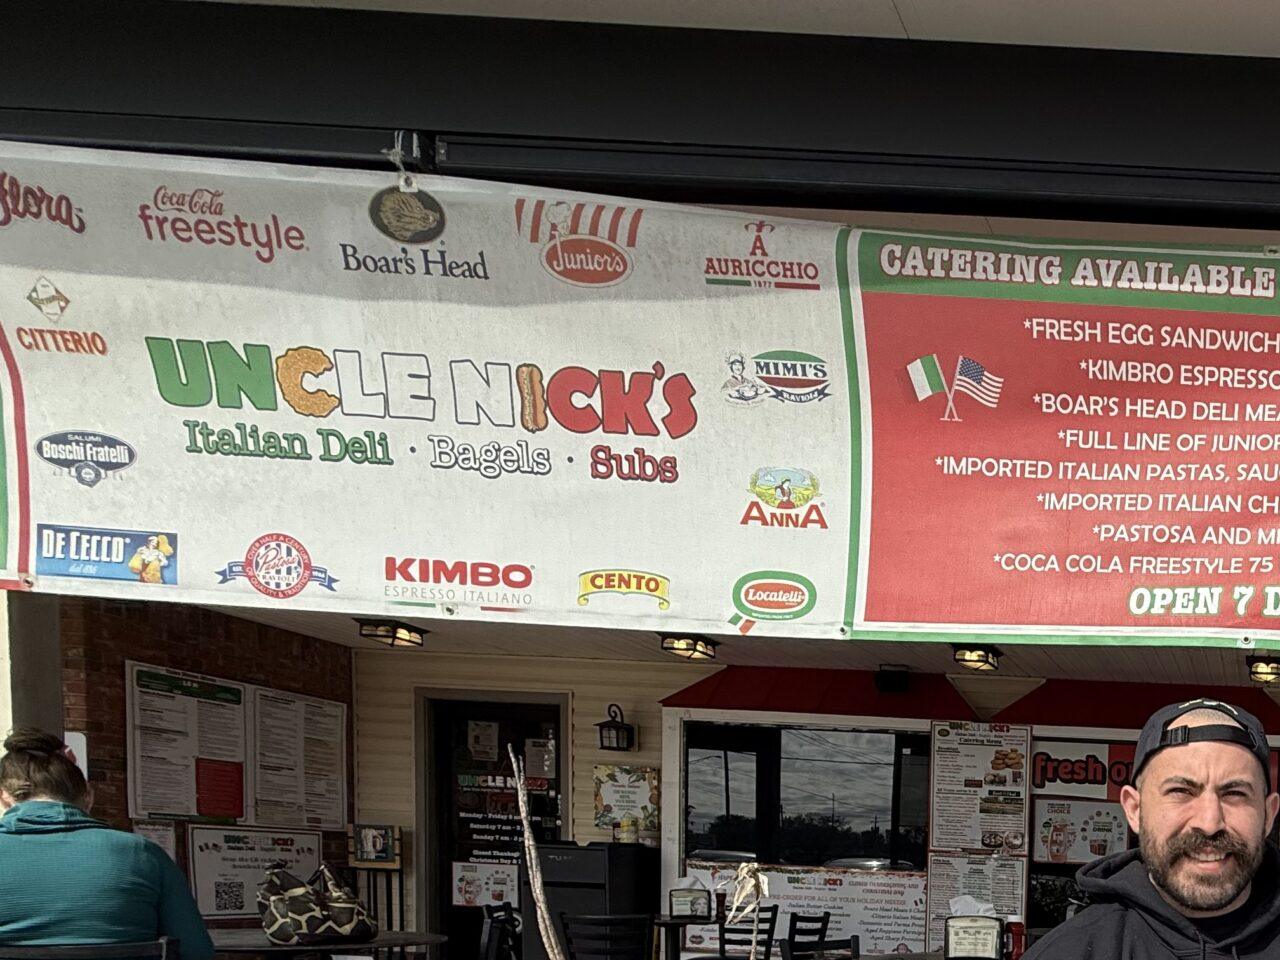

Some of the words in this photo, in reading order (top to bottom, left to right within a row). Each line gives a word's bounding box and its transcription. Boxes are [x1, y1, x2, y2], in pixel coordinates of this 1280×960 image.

[138, 205, 305, 263] freestyle
[339, 242, 417, 275] Boar's
[423, 247, 489, 279] Head
[552, 231, 626, 272] Junior's
[705, 257, 819, 280] AURICCHIO
[880, 243, 1061, 285] CATERING
[1071, 258, 1276, 298] AVAILABLE
[16, 327, 108, 355] CITTERIO
[1108, 323, 1153, 346] EGG
[756, 361, 827, 377] MIMI'S
[144, 336, 436, 422] UNCLE
[450, 360, 698, 439] NICK'S
[1125, 398, 1187, 420] HEAD
[1193, 401, 1238, 421] DELI
[42, 441, 85, 459] Boschi
[86, 444, 129, 463] Fratelli
[184, 419, 311, 461] Italian
[317, 429, 393, 465] Deli
[428, 435, 551, 478] Bagels
[590, 445, 679, 483] Subs
[1124, 432, 1170, 451] LINE
[1176, 434, 1206, 451] OF
[1059, 461, 1140, 480] ITALIAN
[1146, 464, 1230, 483] PASTAS,
[1159, 494, 1242, 513] ITALIAN
[740, 502, 828, 529] ANNA
[42, 529, 65, 558] DE
[69, 532, 124, 562] CECCO
[1202, 527, 1250, 544] AND
[385, 555, 533, 589] KIMBO
[1066, 554, 1123, 574] COLA
[1129, 556, 1242, 574] FREESTYLE
[1249, 557, 1273, 573] 75
[384, 585, 456, 601] ESPRESSO
[464, 590, 532, 605] ITALIANO
[590, 574, 659, 593] CENTO
[748, 589, 803, 602] Locatelli
[1129, 587, 1223, 616] OPEN
[1233, 587, 1255, 616] 7
[1034, 753, 1106, 788] fresh
